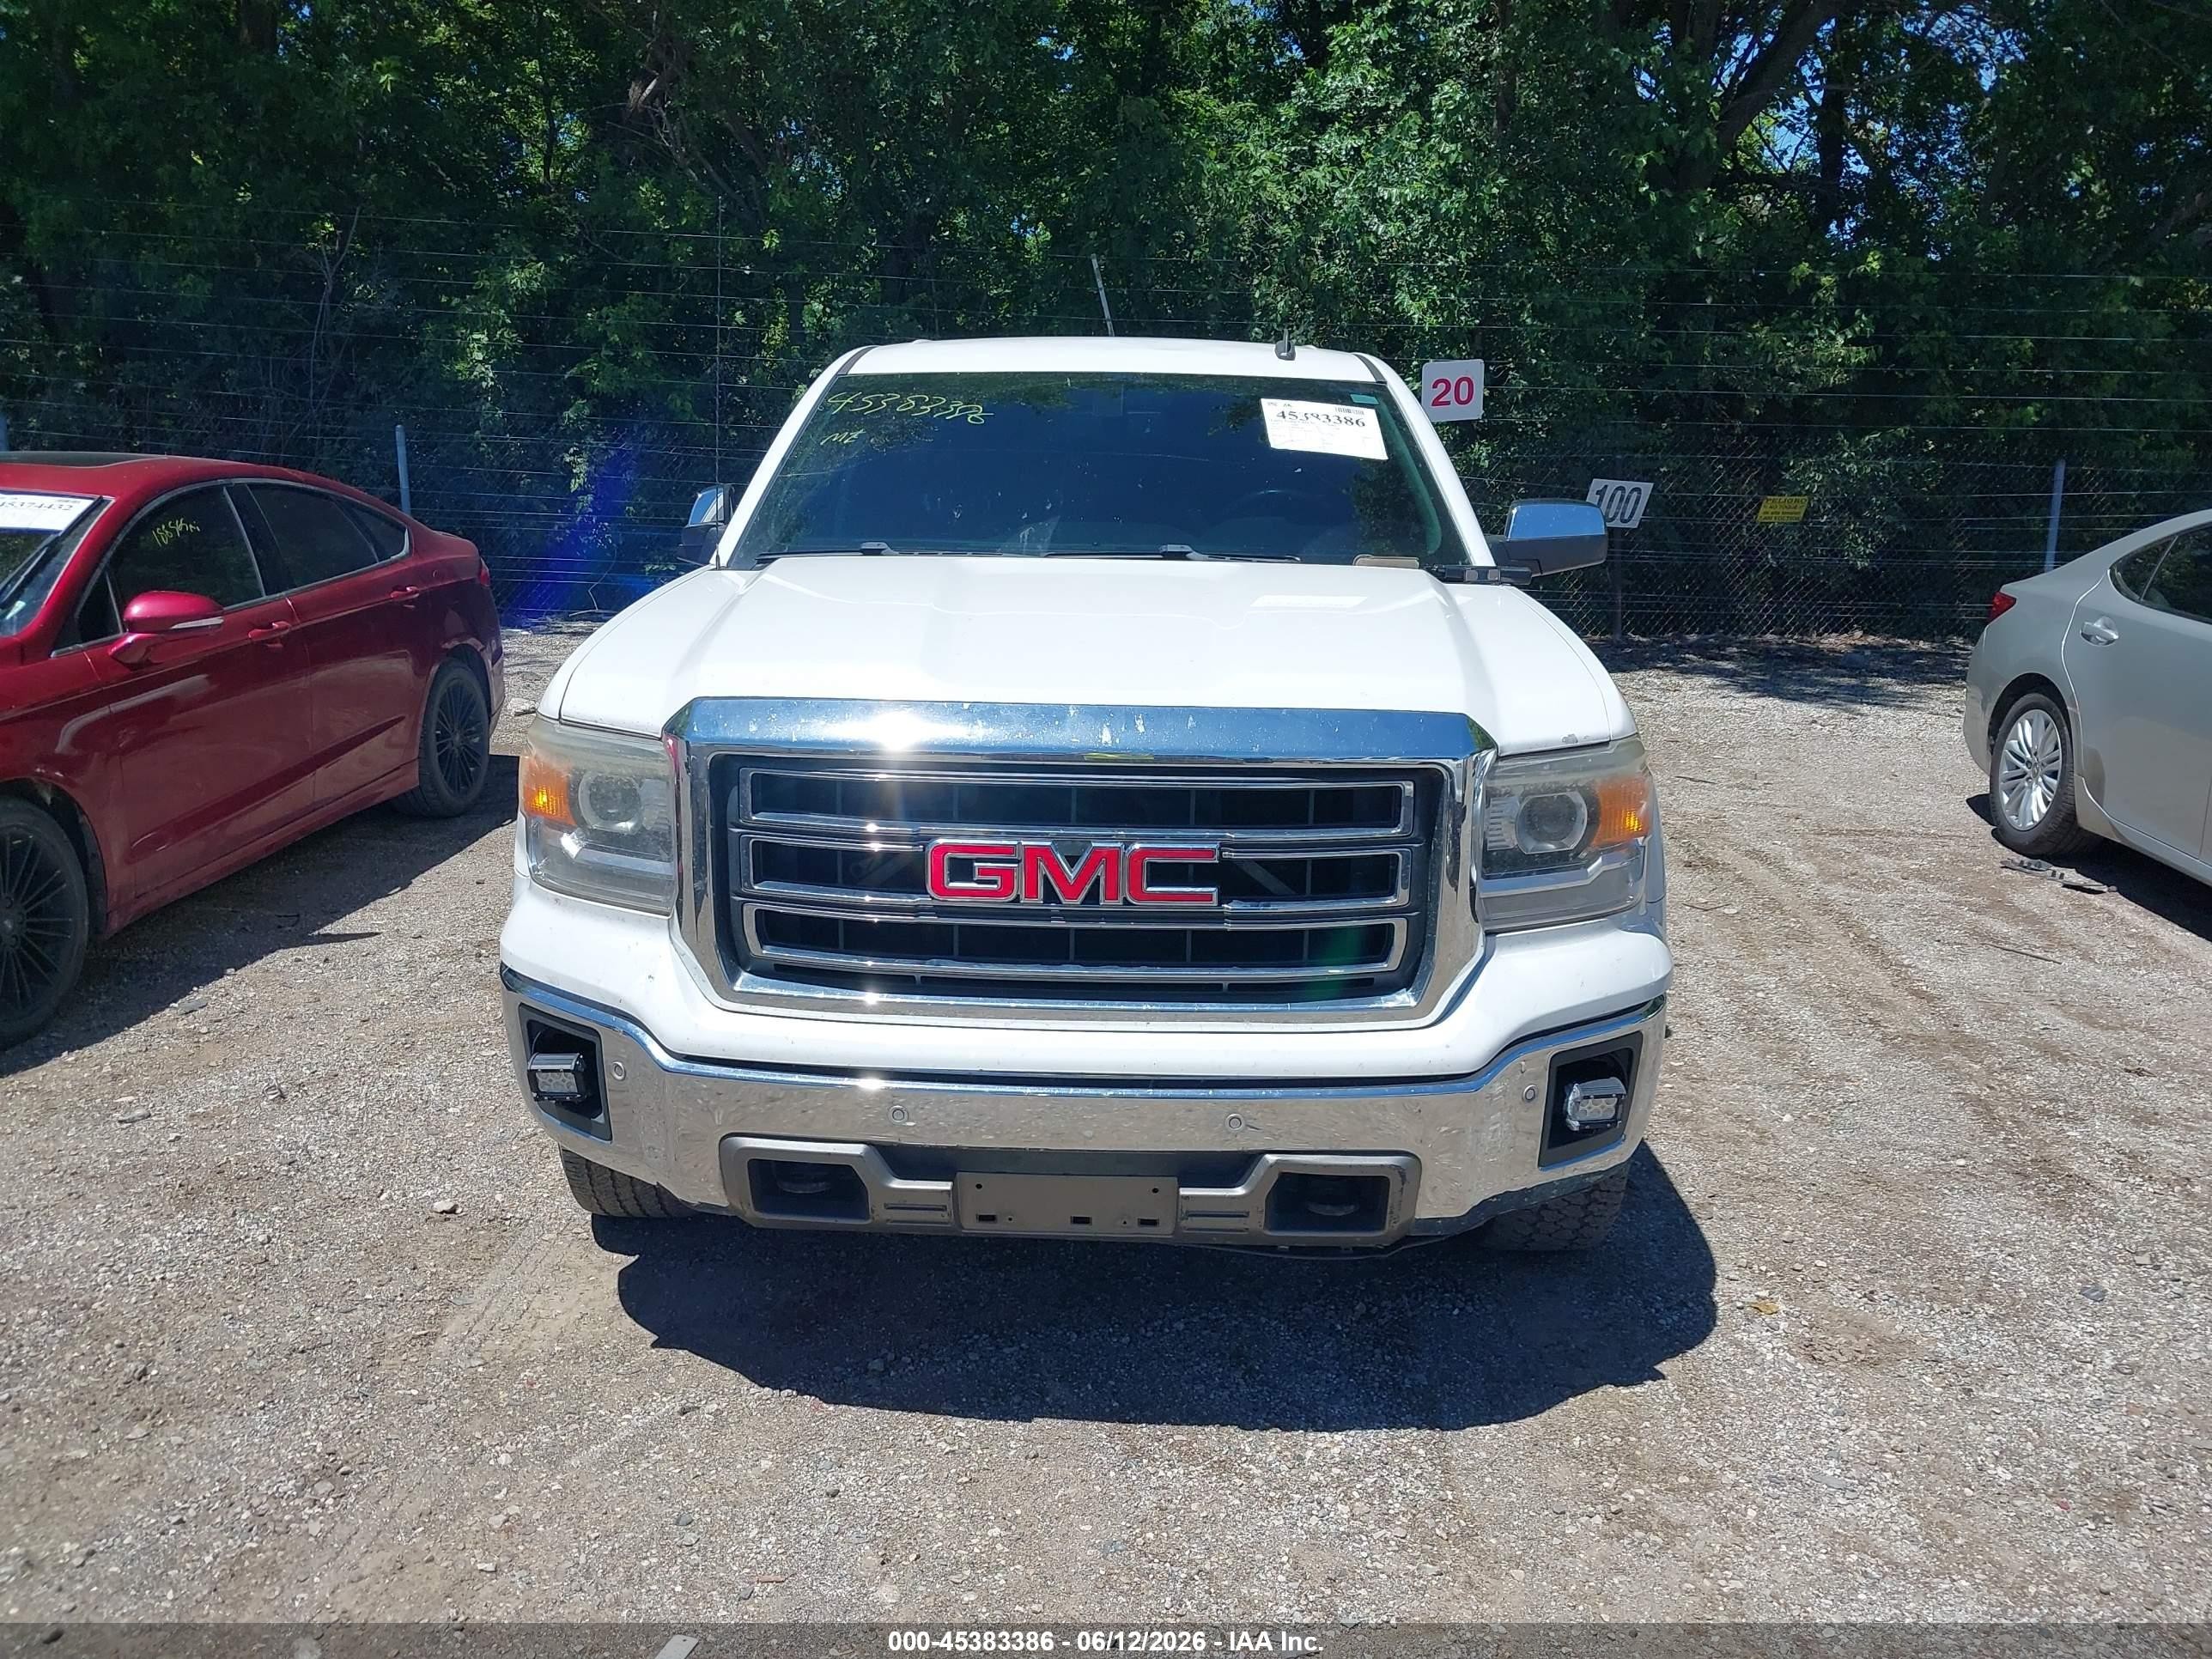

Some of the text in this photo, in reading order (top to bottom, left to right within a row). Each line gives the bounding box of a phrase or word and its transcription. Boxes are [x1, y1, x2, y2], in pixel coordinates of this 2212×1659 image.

[1431, 376, 1475, 407] 20
[1595, 484, 1643, 524] 100
[926, 839, 1220, 905] GMC
